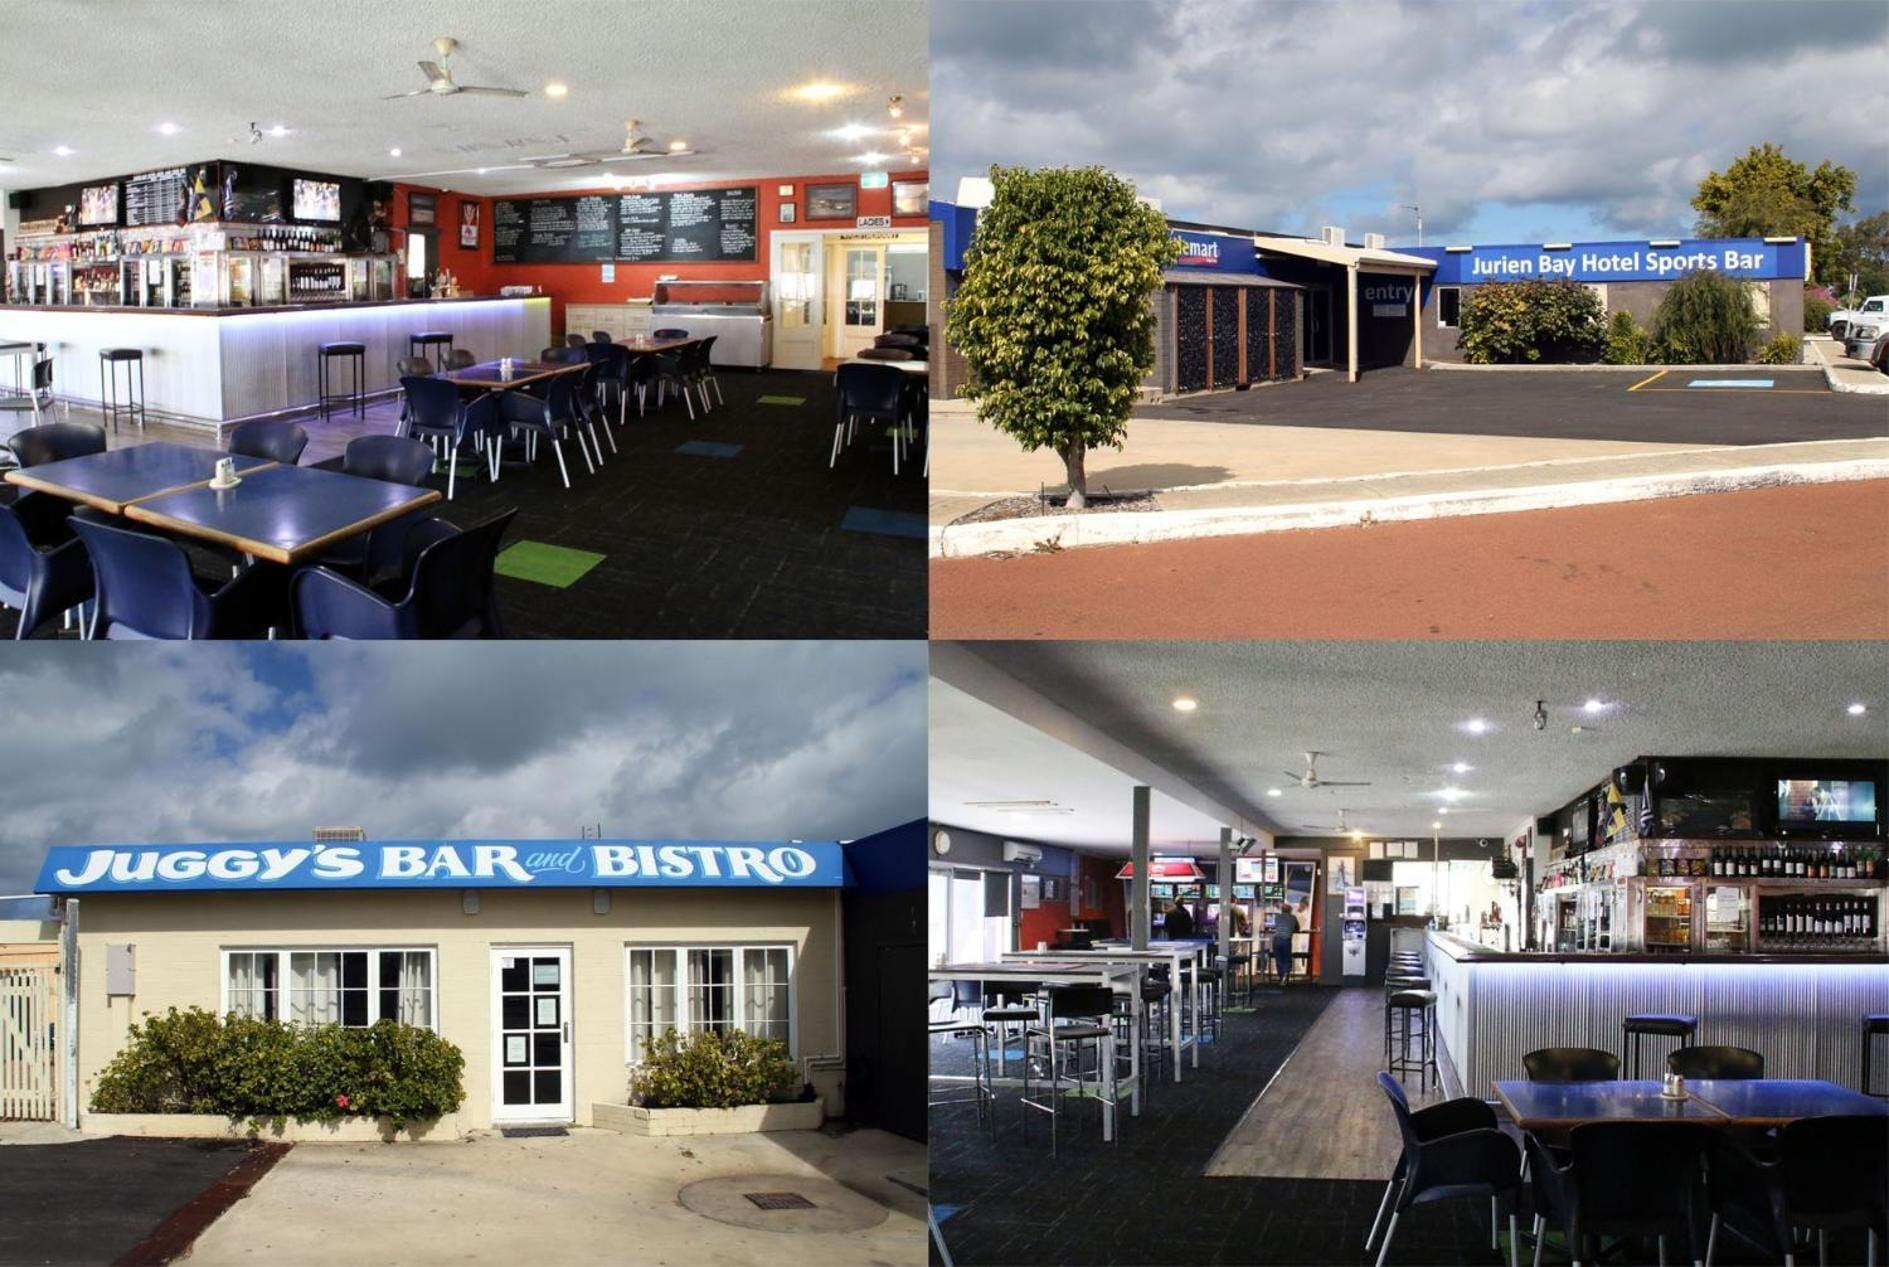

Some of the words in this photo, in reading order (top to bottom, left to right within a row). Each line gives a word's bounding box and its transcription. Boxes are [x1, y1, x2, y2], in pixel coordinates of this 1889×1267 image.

[859, 217, 885, 226] LADIES
[1472, 256, 1533, 275] Jurien
[1538, 254, 1576, 277] Bay
[1582, 251, 1640, 272] Hotel
[1646, 252, 1718, 275] Sports
[1724, 250, 1764, 270] Bar
[1364, 283, 1414, 304] entry
[377, 845, 535, 882] BAR
[525, 846, 586, 874] and
[592, 845, 818, 883] BISTRO
